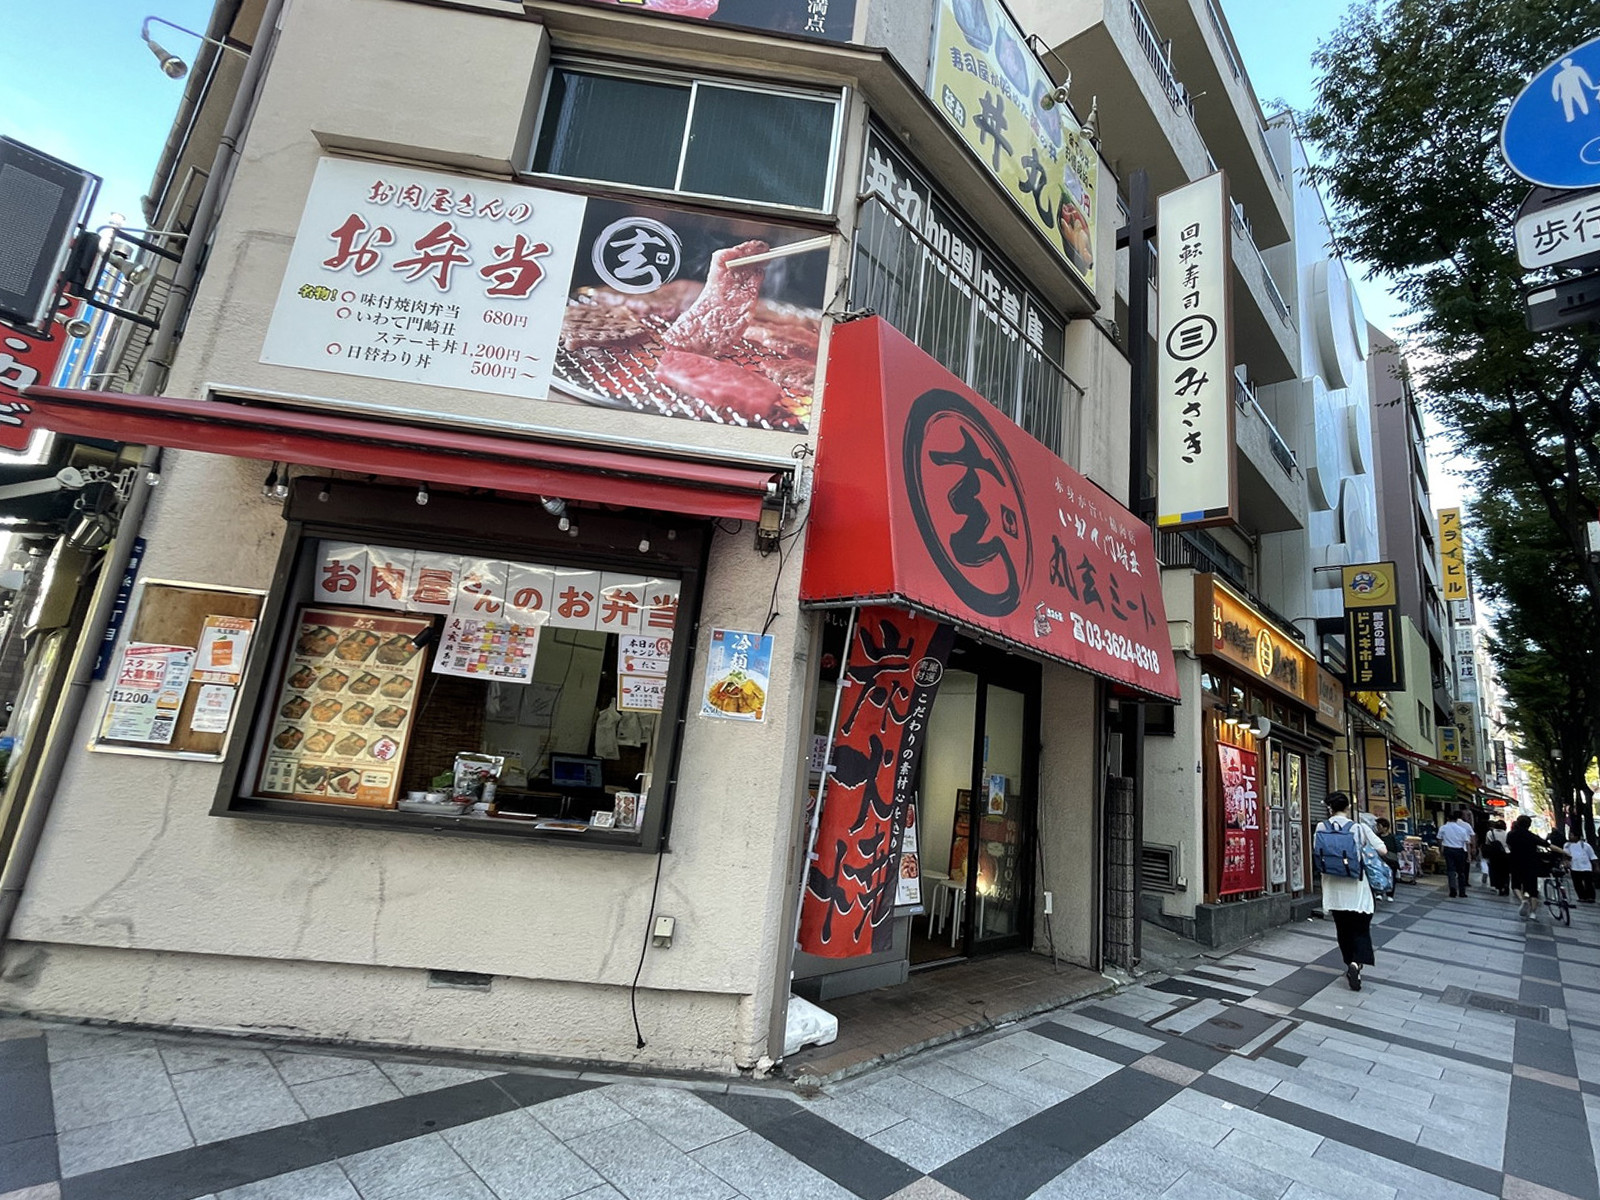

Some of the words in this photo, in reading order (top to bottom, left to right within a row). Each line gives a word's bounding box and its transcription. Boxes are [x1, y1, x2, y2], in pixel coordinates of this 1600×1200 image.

[972, 90, 1055, 229] 丼丸
[368, 180, 530, 221] お肉屋さんの
[323, 213, 549, 296] お弁当
[1178, 222, 1203, 310] 回転寿司
[360, 293, 461, 319] 味付焼肉弁当
[483, 309, 528, 328] 680円
[347, 345, 432, 369] 日替わり丼
[375, 331, 459, 354] ステーキ丼
[1174, 366, 1210, 464] みさき
[1442, 513, 1463, 593] アライビル
[321, 560, 677, 629] お肉屋さんのお弁当
[1049, 535, 1157, 632] 丸玄ミート
[126, 658, 166, 669] スタッフ
[629, 639, 655, 649] 本日の
[1086, 622, 1160, 675] 03-3624-8318
[118, 692, 149, 704] 1200
